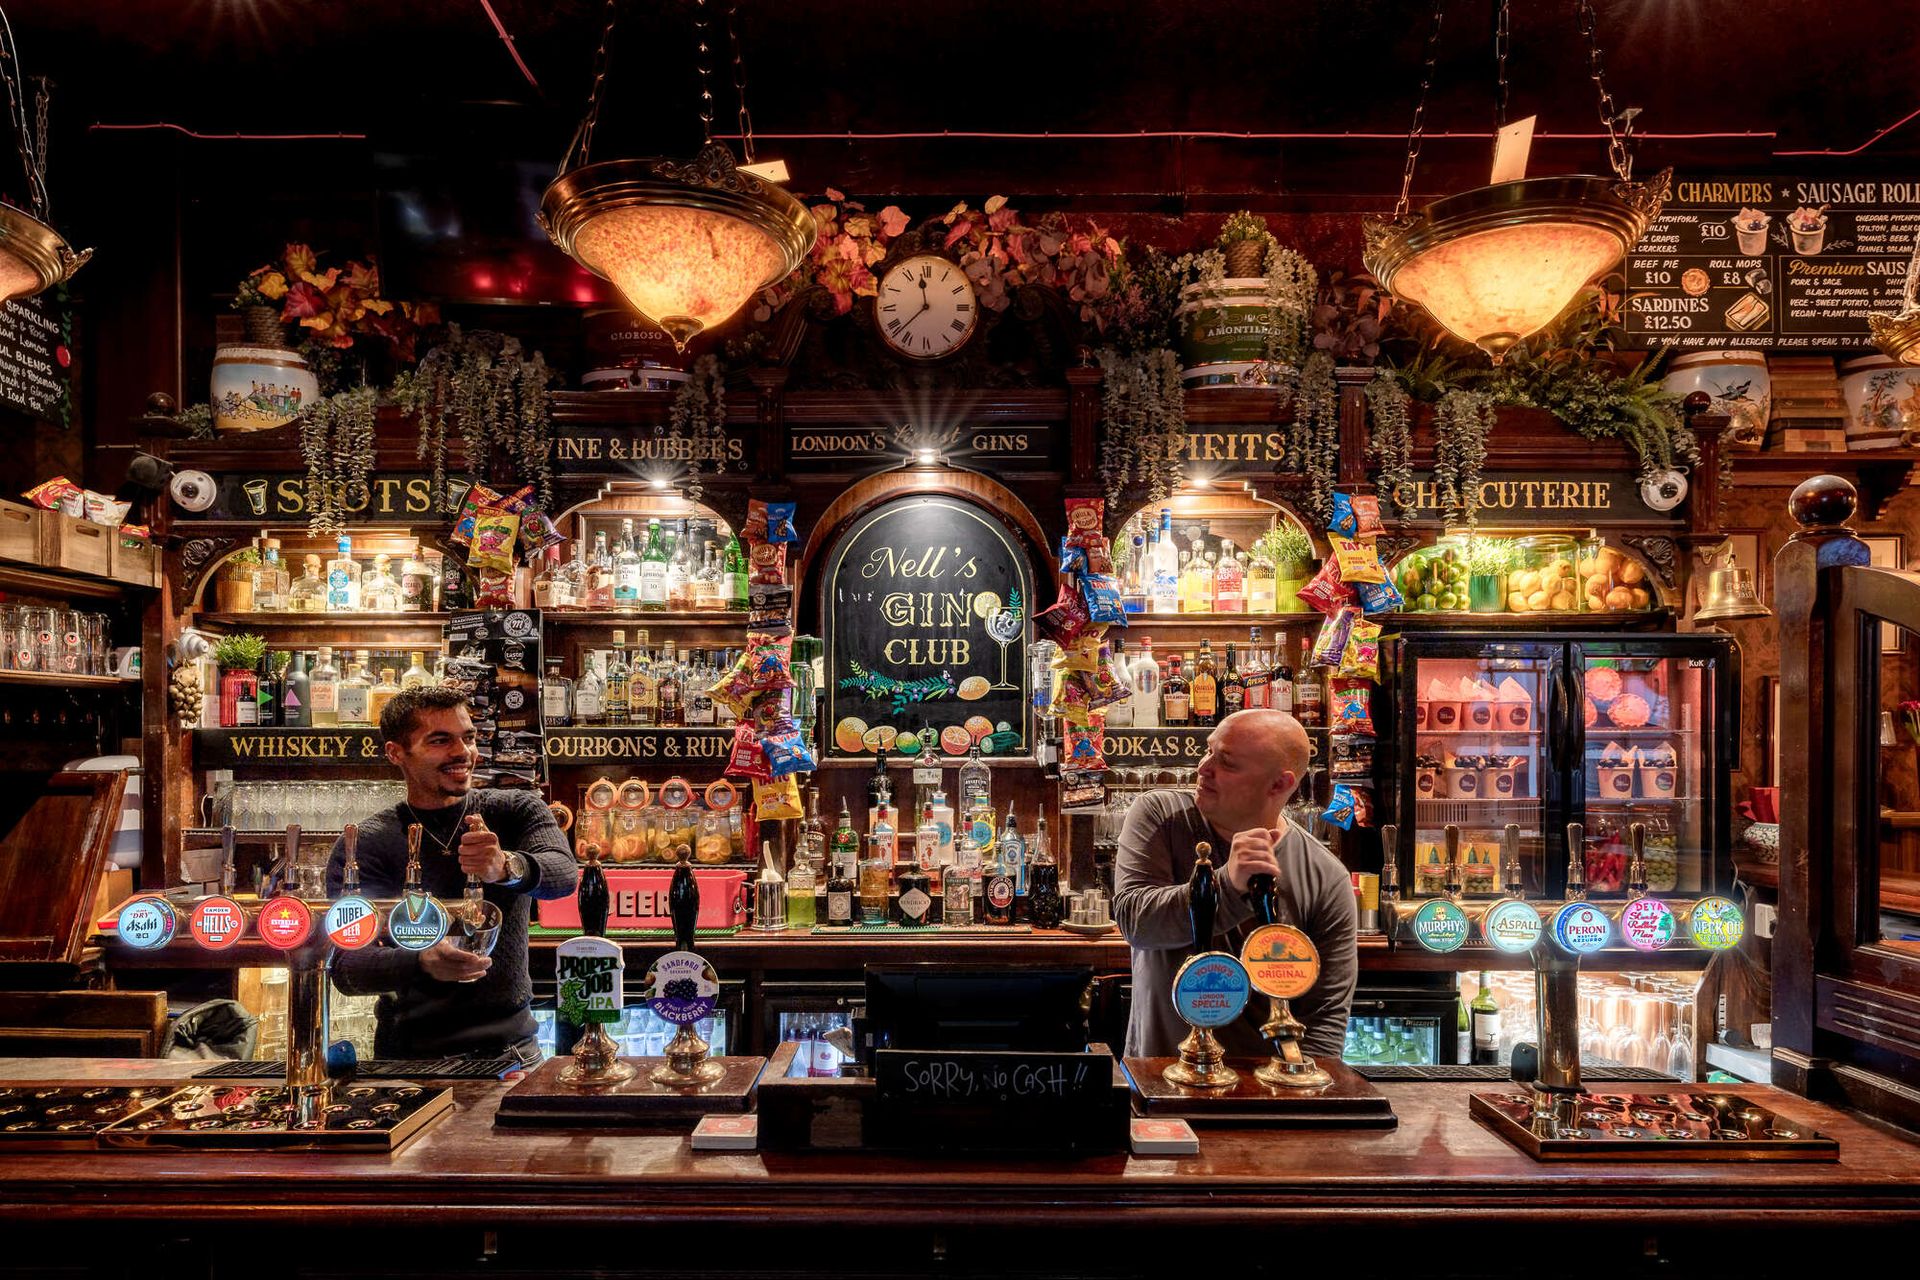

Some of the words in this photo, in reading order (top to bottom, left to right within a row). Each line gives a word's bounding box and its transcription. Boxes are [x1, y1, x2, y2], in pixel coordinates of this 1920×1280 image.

[1677, 182, 1773, 203] CHARMERS
[1796, 182, 1877, 203] SAUSAGE
[1700, 223, 1727, 238] £10
[1651, 235, 1680, 243] GRAPES
[1638, 244, 1678, 253] CRACKERS
[1633, 259, 1659, 269] BEEF
[1663, 259, 1680, 269] PIE
[1709, 259, 1733, 269] ROLL
[1735, 259, 1762, 269] MOPS
[1787, 259, 1865, 276] Premium
[1645, 271, 1671, 284] £10
[1723, 271, 1741, 285] £8
[1790, 278, 1811, 286] PORK
[1813, 278, 1820, 286] &
[1805, 288, 1832, 296] BLACK
[1833, 288, 1869, 296] PUDDING
[1632, 297, 1710, 313] SARDINES
[6, 299, 60, 334] SPARKLING
[1790, 309, 1816, 317] VEGAN
[1822, 309, 1846, 317] PLANT
[1644, 315, 1692, 330] £12.50
[611, 331, 663, 341] OLOROSO
[1646, 337, 1657, 346] IF
[1660, 337, 1681, 346] YOU
[1682, 337, 1704, 346] HAVE
[1707, 337, 1727, 346] ANY
[1730, 337, 1773, 346] ALLERGIES
[1777, 337, 1809, 346] PLEASE
[1811, 337, 1838, 346] SPEAK
[1841, 337, 1851, 346] TO
[1852, 337, 1859, 346] A
[20, 334, 50, 356] Lemon
[15, 350, 53, 376] BLENDS
[7, 387, 26, 406] Iced
[28, 396, 45, 412] Tea
[549, 437, 602, 460] INE
[608, 438, 628, 460] &
[791, 431, 886, 451] LONDON'S
[972, 434, 1029, 451] GINS
[1167, 433, 1286, 462] PIRITS
[861, 546, 978, 579] Nell's
[879, 591, 974, 628] GIN
[883, 638, 971, 666] CLUB
[229, 736, 353, 758] WHISKEY
[361, 737, 379, 758] &
[547, 736, 657, 758] OURBONS
[664, 736, 682, 758] &
[1102, 736, 1180, 757] ODKAS
[1185, 737, 1200, 757] &
[609, 890, 672, 917] EER
[1635, 902, 1664, 912] DEYA
[126, 917, 158, 932] Asahi
[203, 915, 231, 934] HELLS
[336, 906, 364, 928] JUBEL
[1500, 917, 1541, 931] ASPALL
[342, 923, 361, 937] BEER
[395, 926, 438, 936] GUINNESS
[1418, 919, 1465, 934] MURPHY'S
[1569, 925, 1606, 935] PERONI
[1632, 929, 1654, 939] Man
[1695, 920, 1722, 935] NECK
[1727, 920, 1743, 935] OIL
[1258, 932, 1298, 947] YOUNG'S
[557, 956, 620, 979] PROPER
[1194, 963, 1234, 977] YOUNG'S
[1257, 969, 1307, 979] ORIGINAL
[578, 971, 614, 999] JOB
[591, 996, 615, 1009] IPA
[1191, 1000, 1231, 1009] SPECIAL
[654, 1001, 709, 1022] BLACKBERRY
[904, 1061, 979, 1097] SORRY,
[983, 1065, 1007, 1089] NO
[1012, 1063, 1068, 1096] CASH
